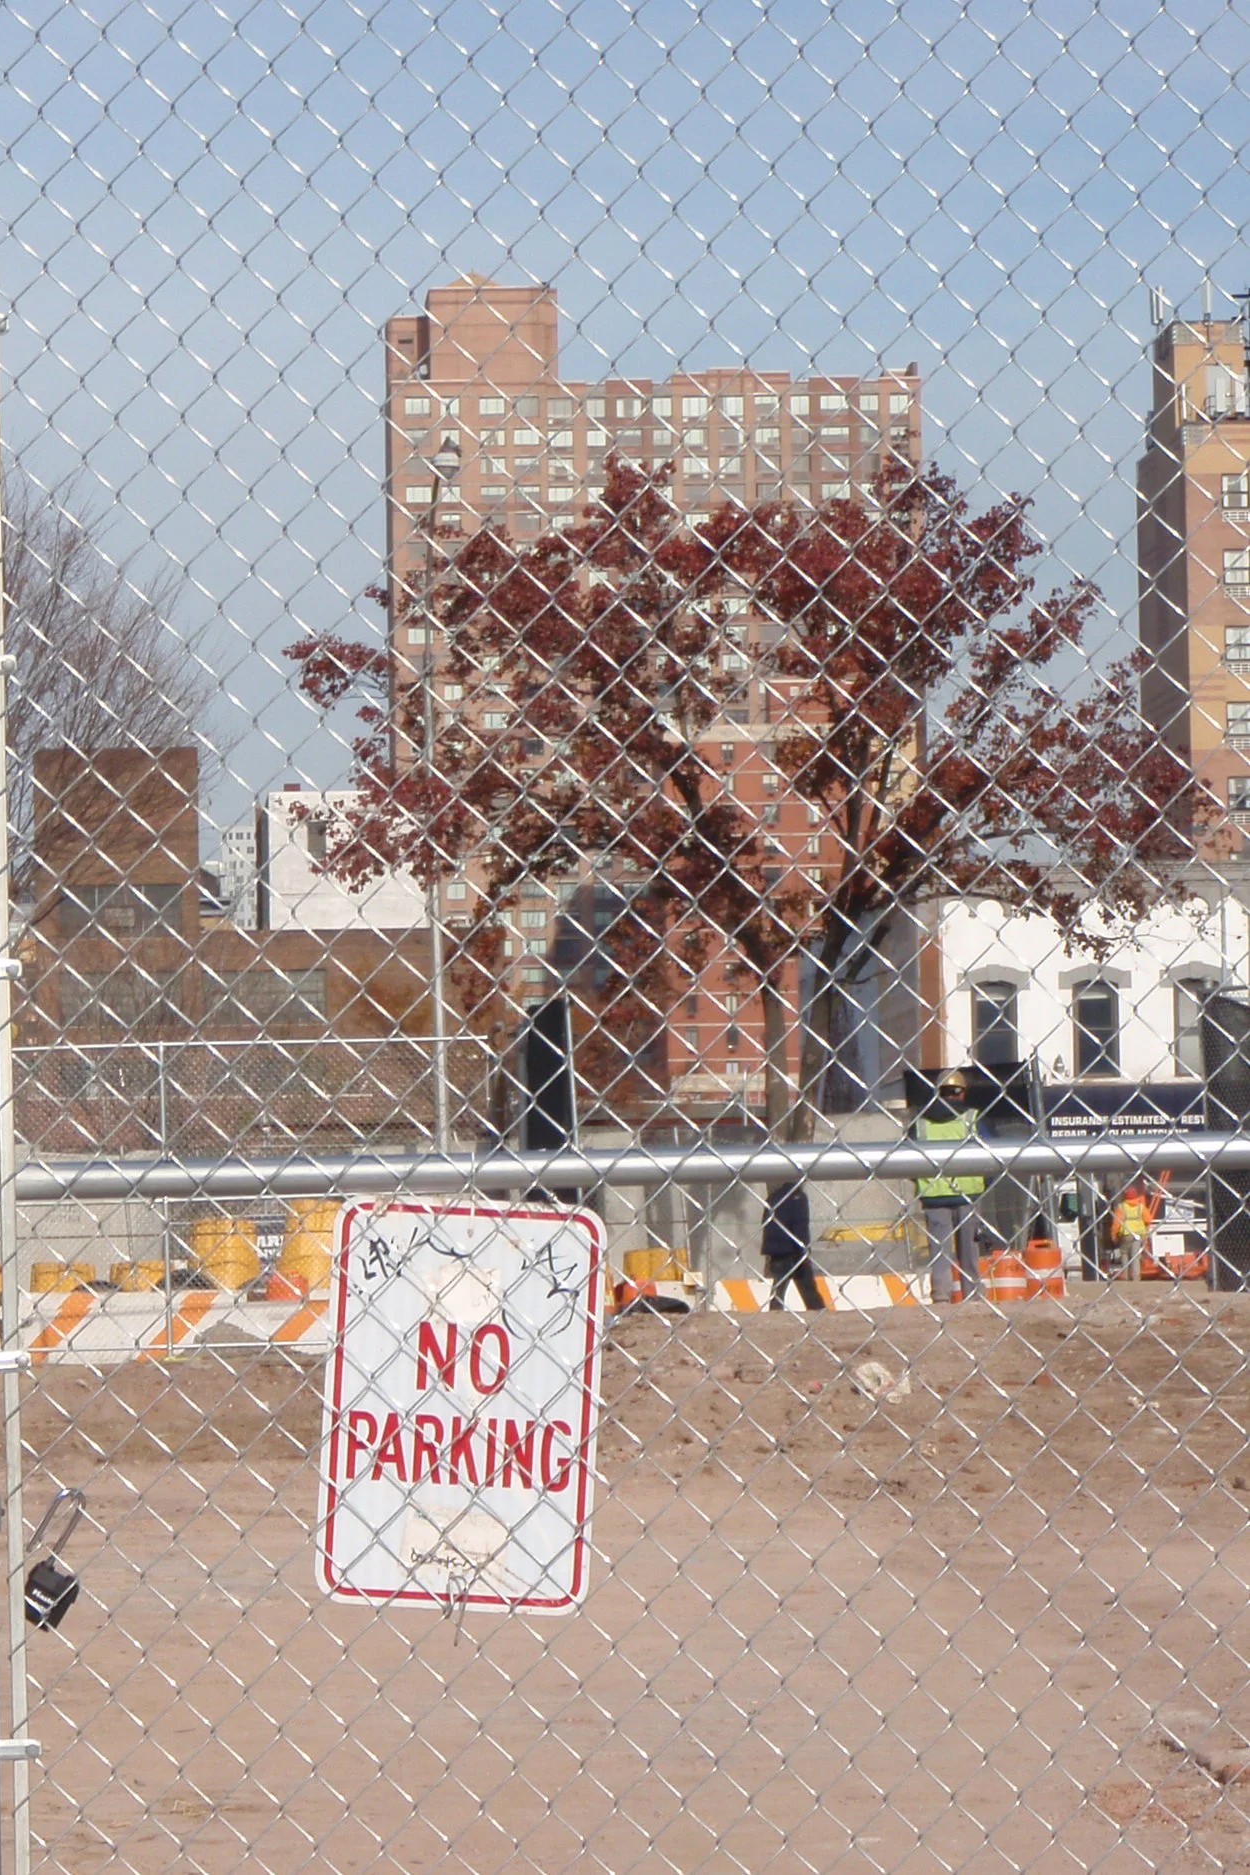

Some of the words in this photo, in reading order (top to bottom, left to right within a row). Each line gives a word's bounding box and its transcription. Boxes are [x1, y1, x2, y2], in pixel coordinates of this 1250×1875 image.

[1111, 1115, 1166, 1125] ESTIMATES
[416, 1321, 511, 1395] NO
[345, 1410, 574, 1493] PARKING
